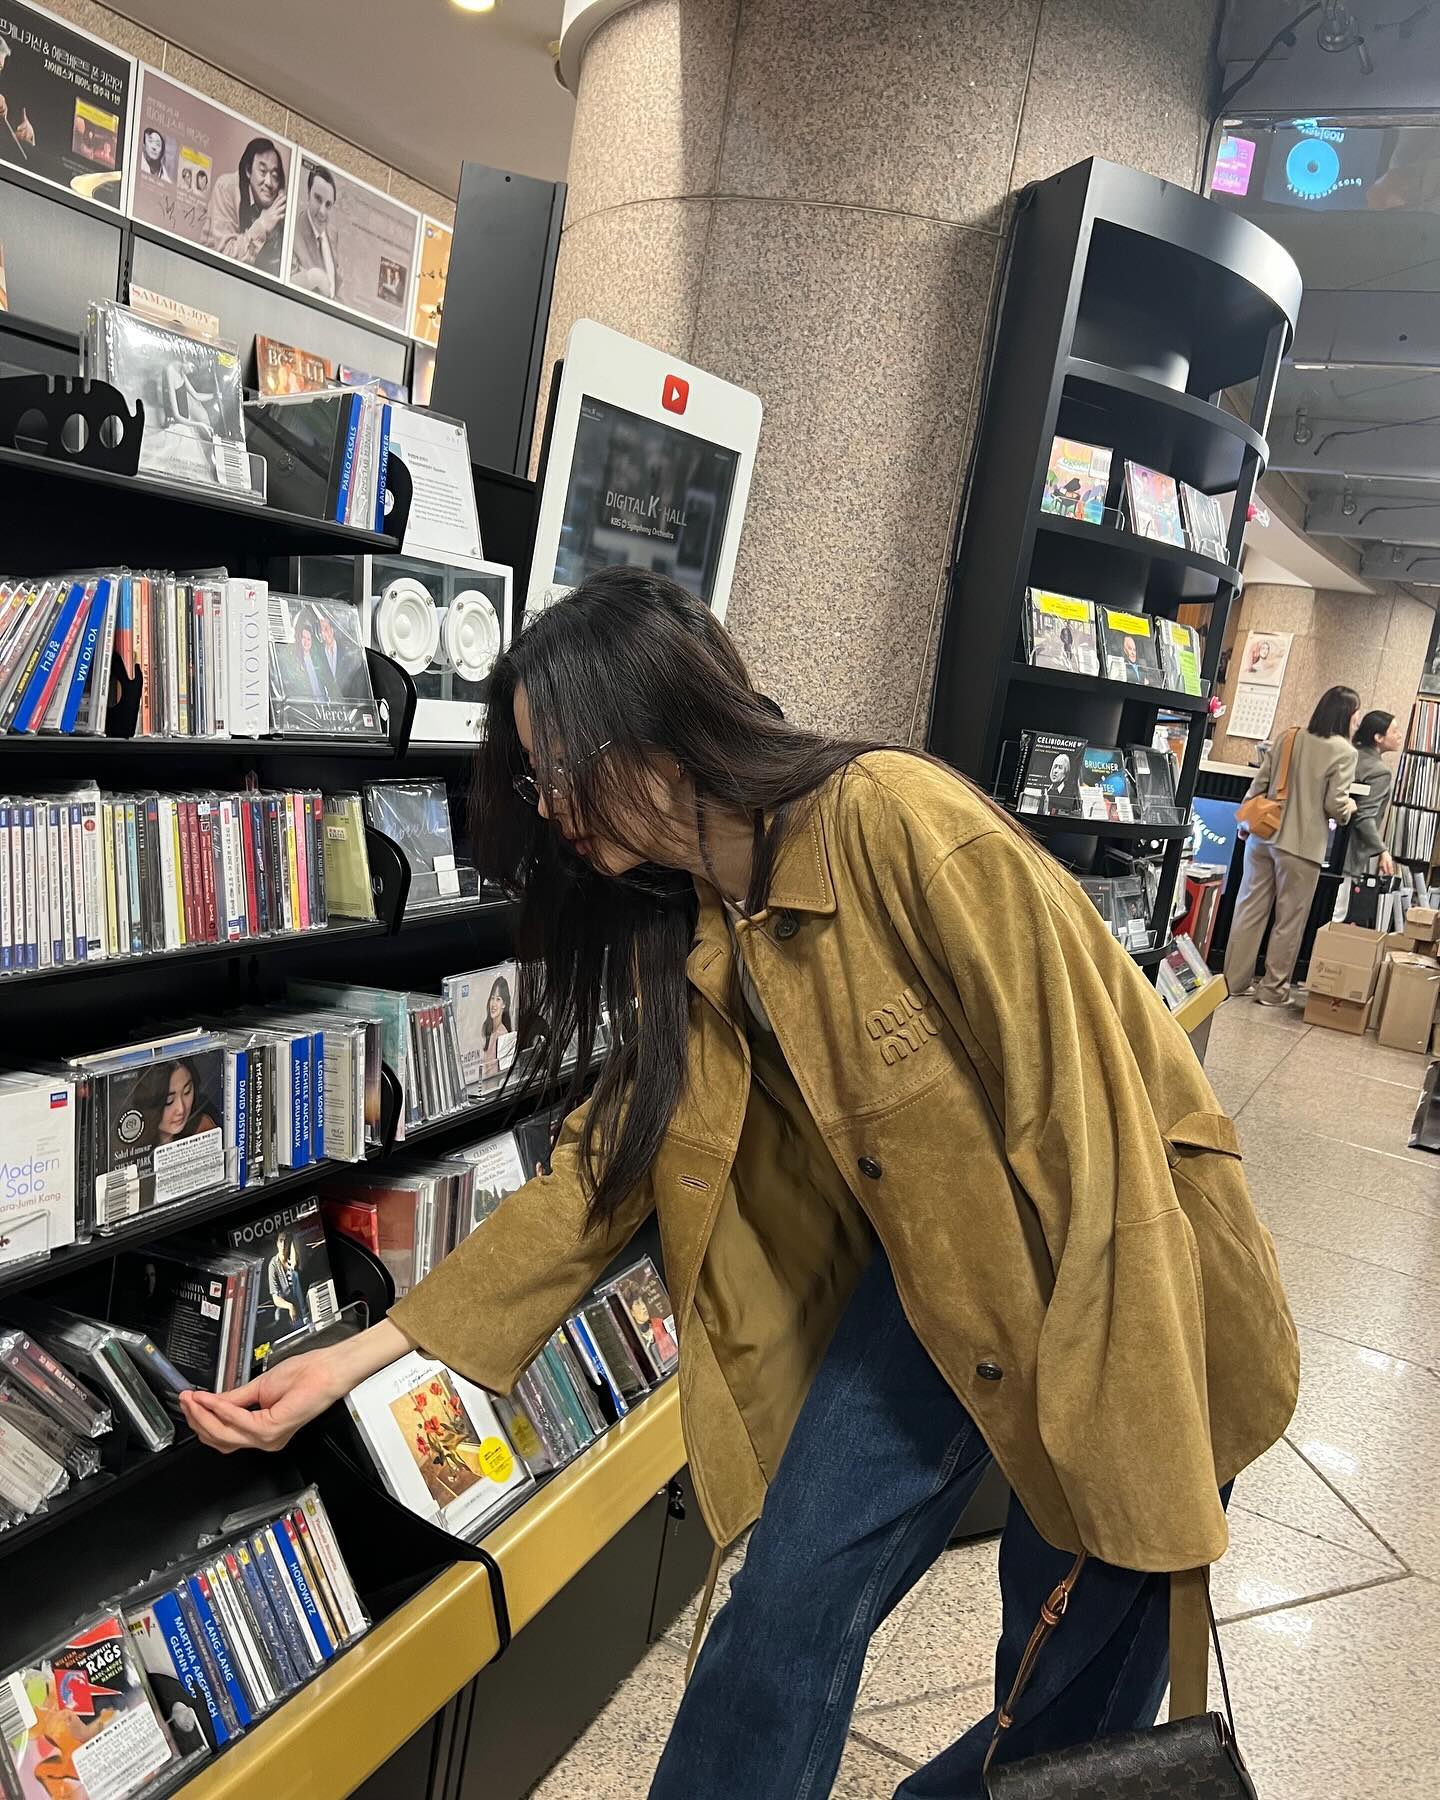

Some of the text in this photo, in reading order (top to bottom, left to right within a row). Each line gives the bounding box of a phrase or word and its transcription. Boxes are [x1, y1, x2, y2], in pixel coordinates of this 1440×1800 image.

[341, 424, 356, 490] PABLO CASALS
[380, 434, 390, 473] STARKER
[606, 490, 647, 516] DIGITAL
[610, 517, 674, 540] KBS Symphony Orchestra
[38, 639, 60, 672] 장한나
[76, 627, 97, 682] YO-YO MA
[1036, 736, 1076, 747] CELIBIDACHE
[1084, 759, 1119, 771] BRUCKNER
[236, 1080, 247, 1159] DAVID OISTRAKH
[292, 1059, 302, 1147] ARTHUR GRUMIAUX
[300, 1061, 309, 1140] MICHELE AUCLAIR
[316, 1095, 324, 1127] KOGAN
[4, 1176, 45, 1198] Solo
[38, 1191, 61, 1202] Kang
[232, 1199, 317, 1247] POGORELICH
[289, 1561, 317, 1616] HOROWITZ
[84, 1643, 123, 1675] RAGS
[168, 1634, 189, 1672] GLENN
[173, 1615, 218, 1718] MARTHA ARGERICH
[203, 1619, 234, 1682] LANG-LANG
